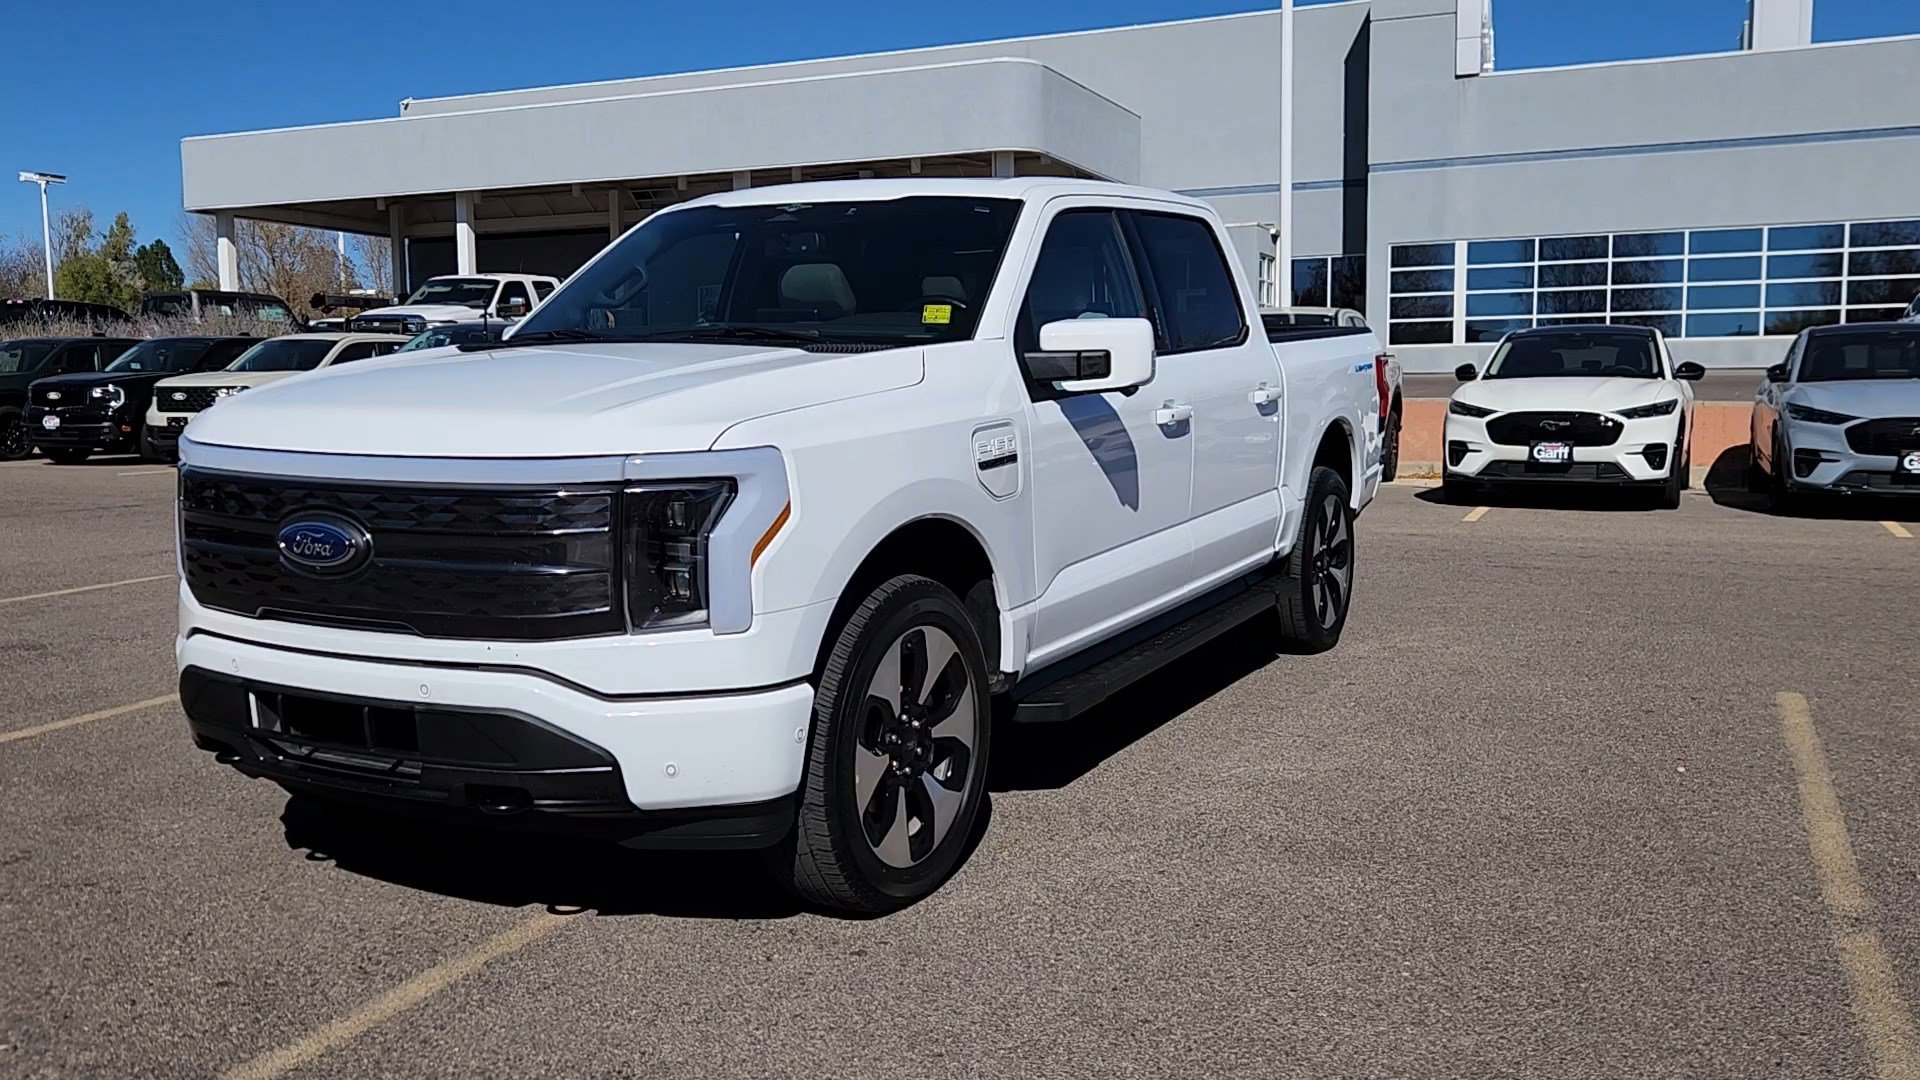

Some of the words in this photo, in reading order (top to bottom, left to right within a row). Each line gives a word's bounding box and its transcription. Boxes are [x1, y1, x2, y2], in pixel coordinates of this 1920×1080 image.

[975, 434, 1016, 460] F-150
[1533, 445, 1569, 460] Garff
[292, 530, 335, 557] Ford
